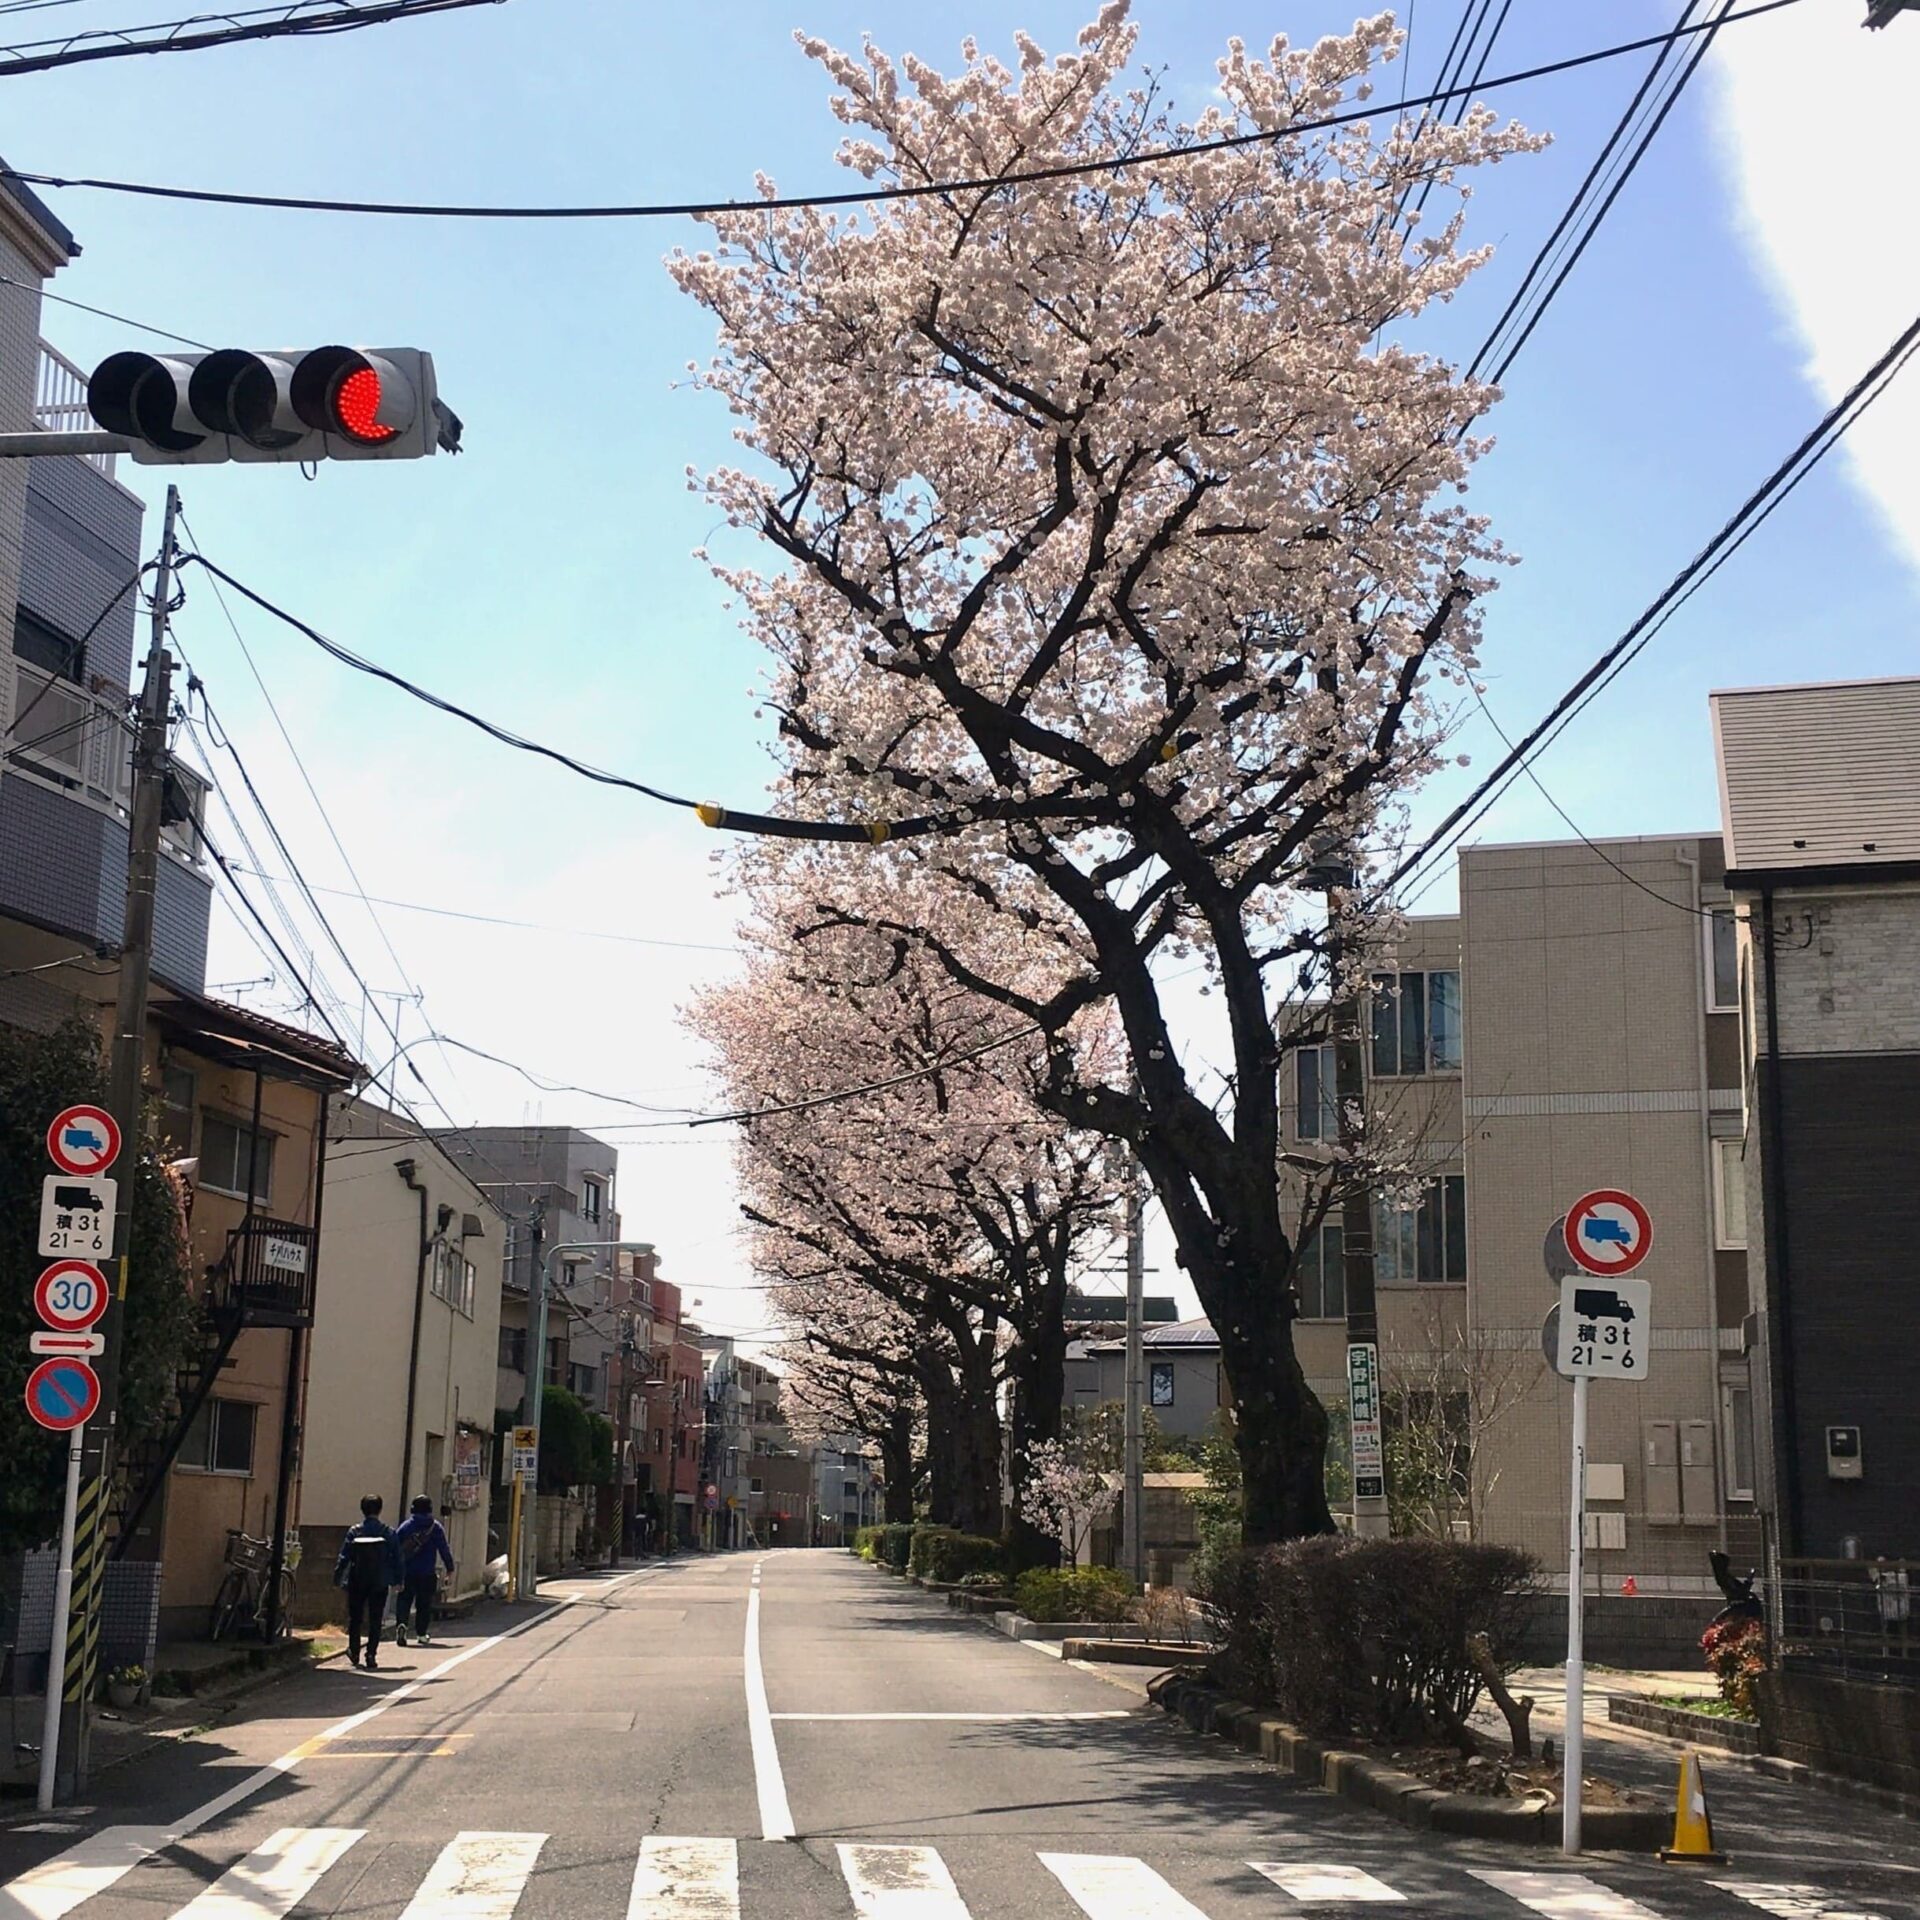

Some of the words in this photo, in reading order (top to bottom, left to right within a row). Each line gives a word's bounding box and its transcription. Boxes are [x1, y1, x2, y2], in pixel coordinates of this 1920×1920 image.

[56, 1214, 72, 1230] 積
[78, 1215, 100, 1231] 3t
[52, 1280, 92, 1311] 30
[1577, 1323, 1597, 1344] 積
[1604, 1325, 1631, 1346] 3t
